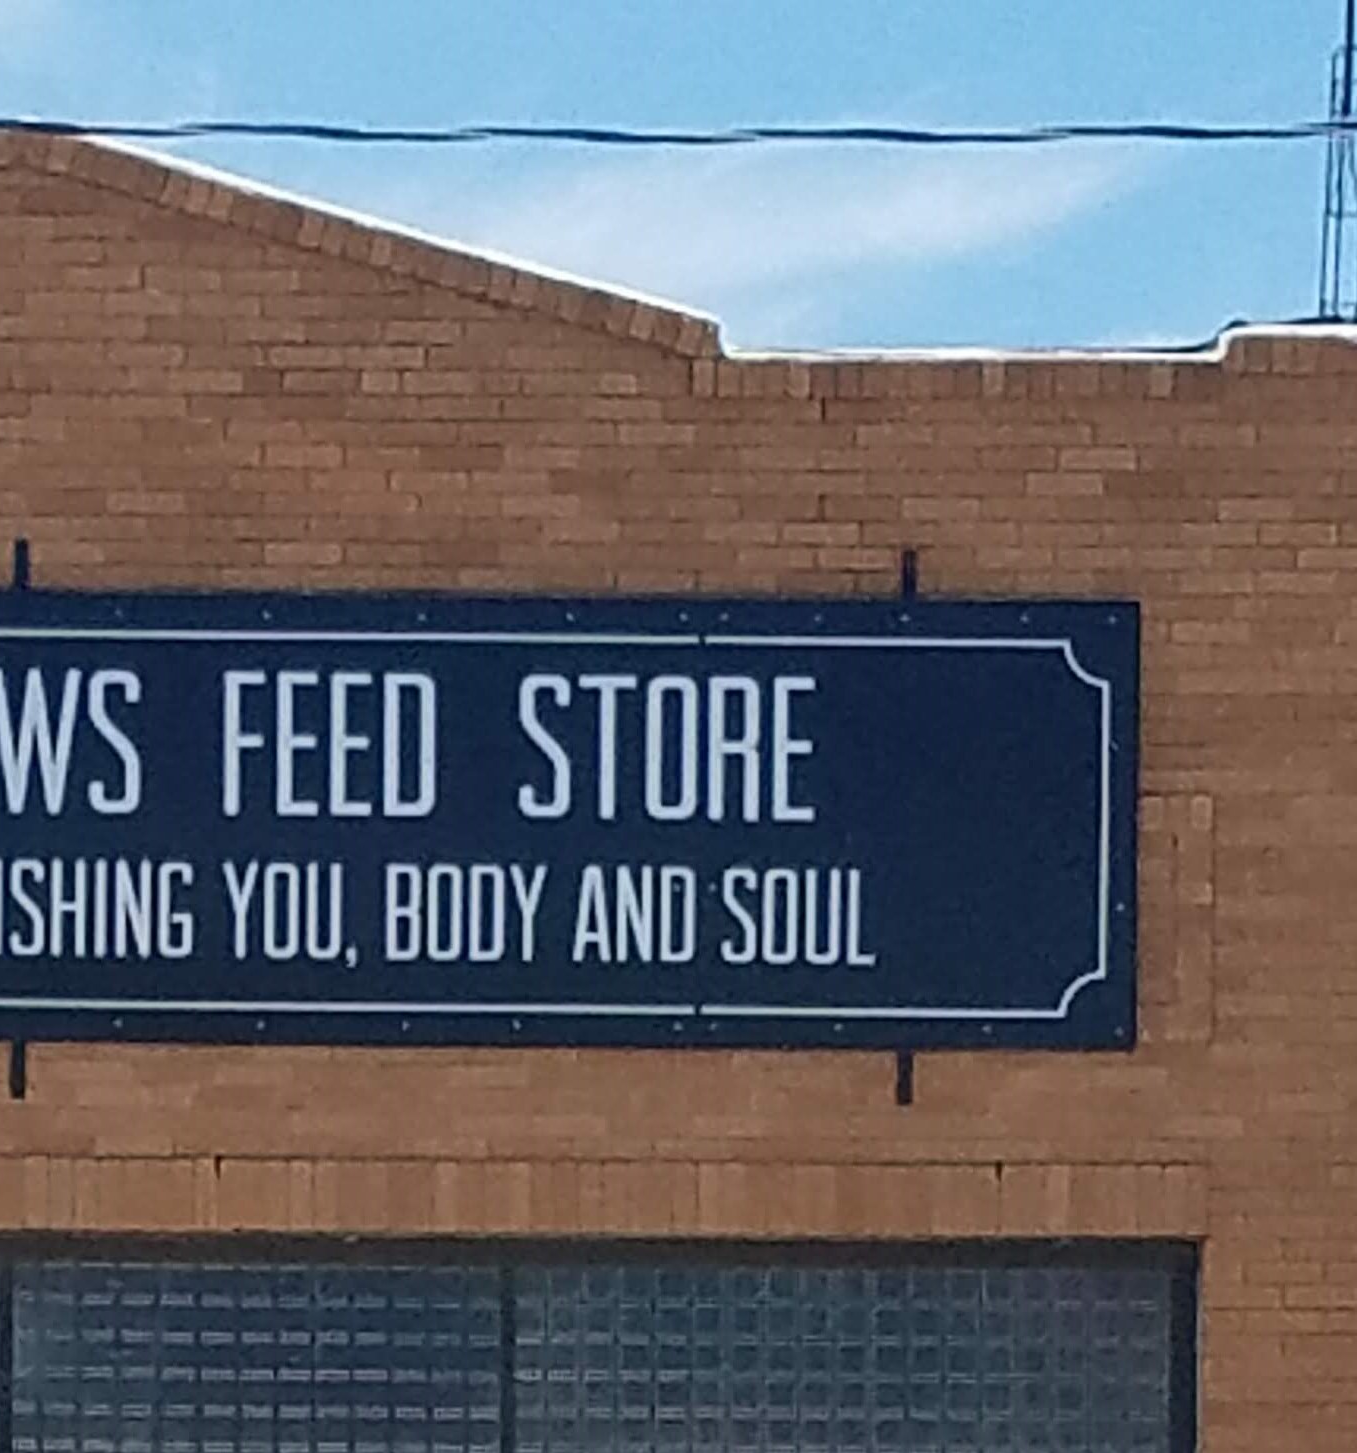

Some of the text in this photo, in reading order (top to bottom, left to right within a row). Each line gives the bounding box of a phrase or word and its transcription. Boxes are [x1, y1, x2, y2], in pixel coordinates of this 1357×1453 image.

[223, 670, 437, 818] FEED
[518, 673, 816, 823] STORE
[222, 859, 359, 967] YOU,
[385, 863, 547, 963] BODY
[573, 864, 697, 964] AND
[720, 866, 876, 966] SOUL
